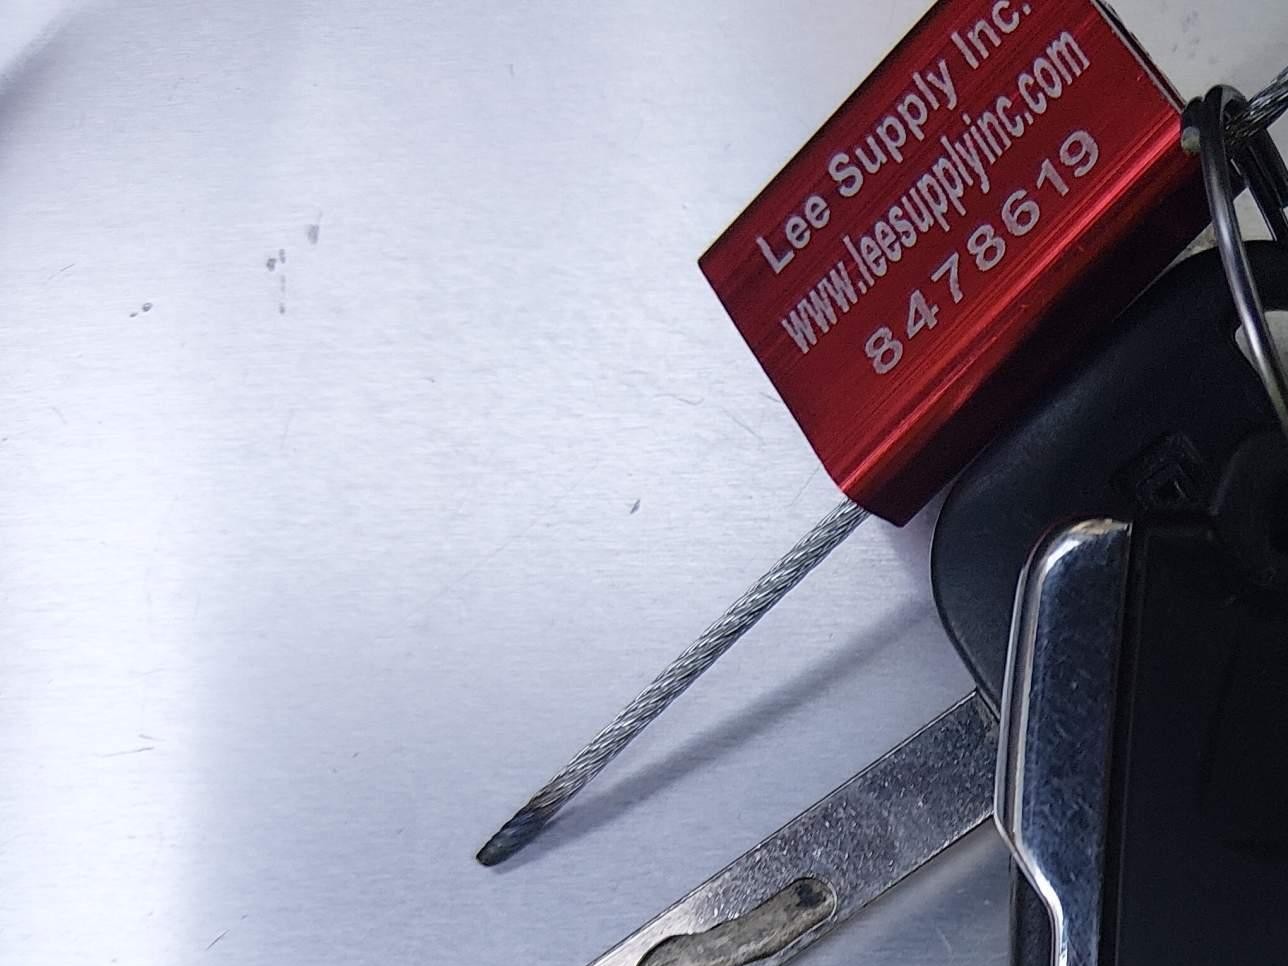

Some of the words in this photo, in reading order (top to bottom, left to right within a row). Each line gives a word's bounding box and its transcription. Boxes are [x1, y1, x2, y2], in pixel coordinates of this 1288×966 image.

[756, 195, 830, 274] Lee
[829, 58, 959, 198] Supply
[950, 0, 1032, 70] Inc.
[781, 31, 1091, 354] www.leesupplyinc.com
[865, 129, 1099, 374] 8478619
